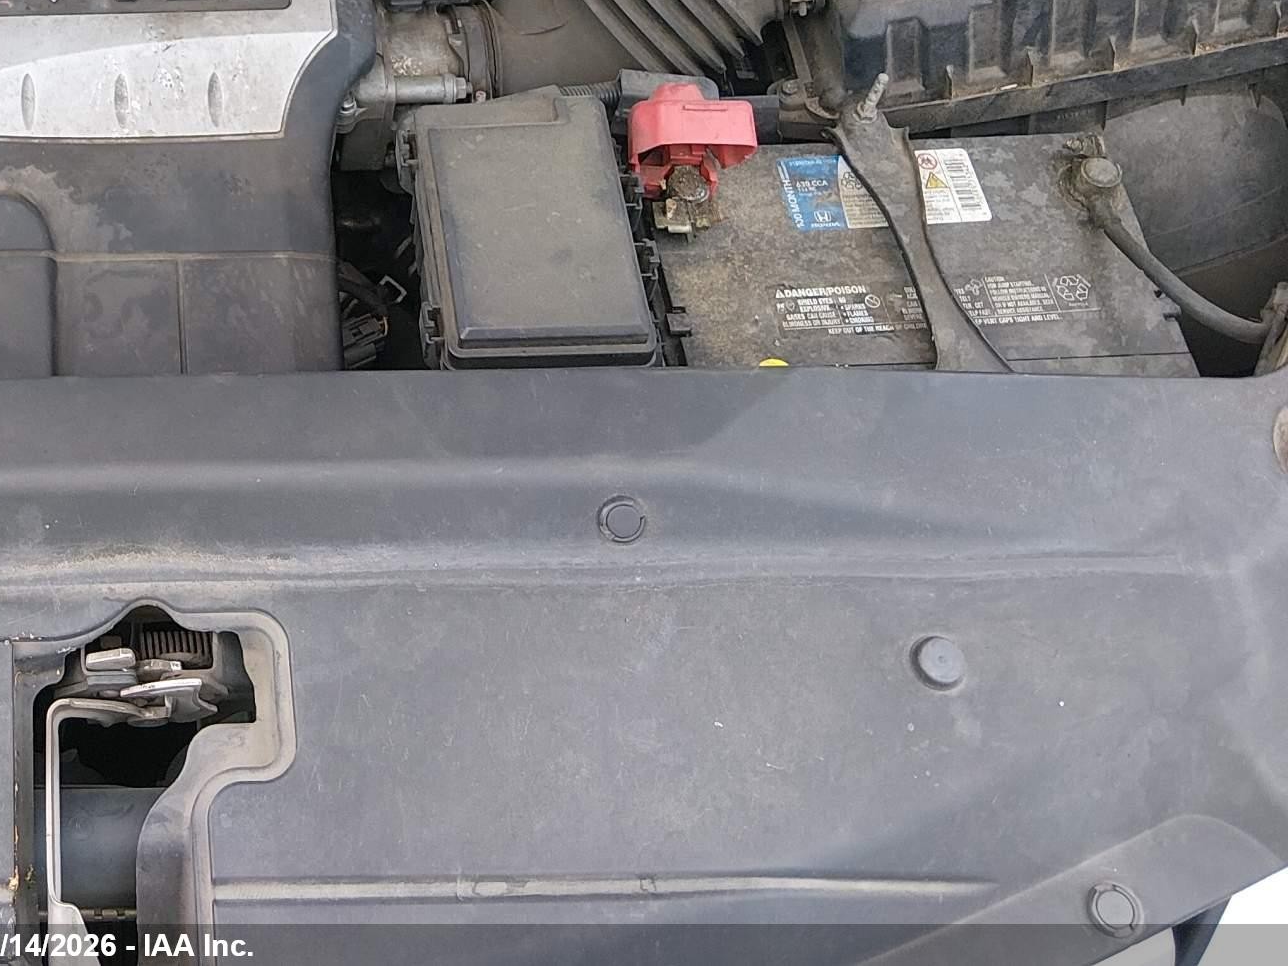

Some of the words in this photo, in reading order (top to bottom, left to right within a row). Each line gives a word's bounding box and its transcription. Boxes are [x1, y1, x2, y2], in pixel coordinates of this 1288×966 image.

[811, 179, 828, 187] CCA
[782, 179, 800, 212] MONTH
[784, 285, 867, 298] DANGER/POISON
